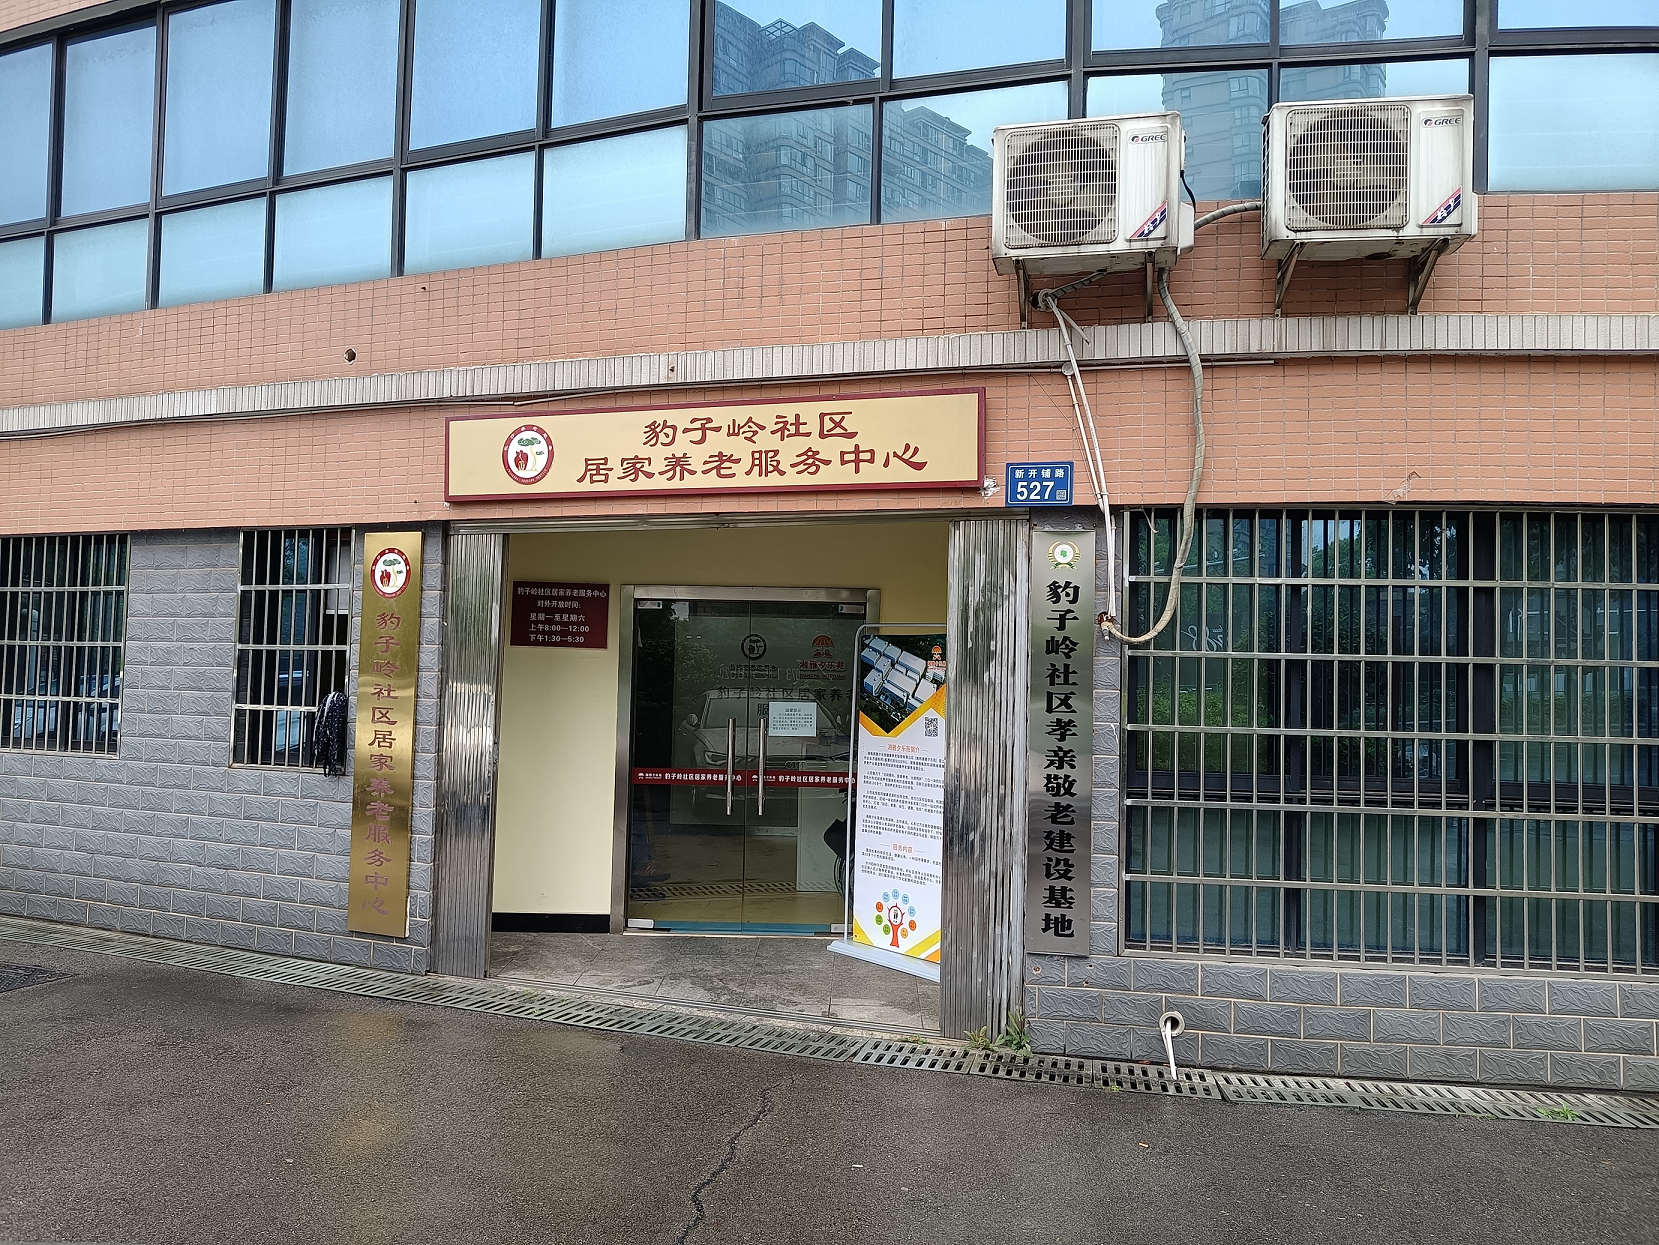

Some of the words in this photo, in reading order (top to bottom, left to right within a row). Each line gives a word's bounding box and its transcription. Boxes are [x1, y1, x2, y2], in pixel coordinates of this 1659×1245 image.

[1434, 116, 1462, 126] GREE
[1140, 134, 1167, 143] GREE
[642, 411, 859, 448] 豹子岭社区
[576, 442, 929, 485] 居家养老服务中心
[1014, 468, 1065, 479] 新开铺路
[1016, 481, 1055, 501] 527
[517, 587, 607, 598] 豹子岭社区居家养老服务中心
[529, 612, 586, 622] 星期一至星期六
[360, 611, 402, 916] 豹子岭社区居家养老服务中心
[1040, 579, 1081, 939] 豹子岭社区孝亲敬老建设基地
